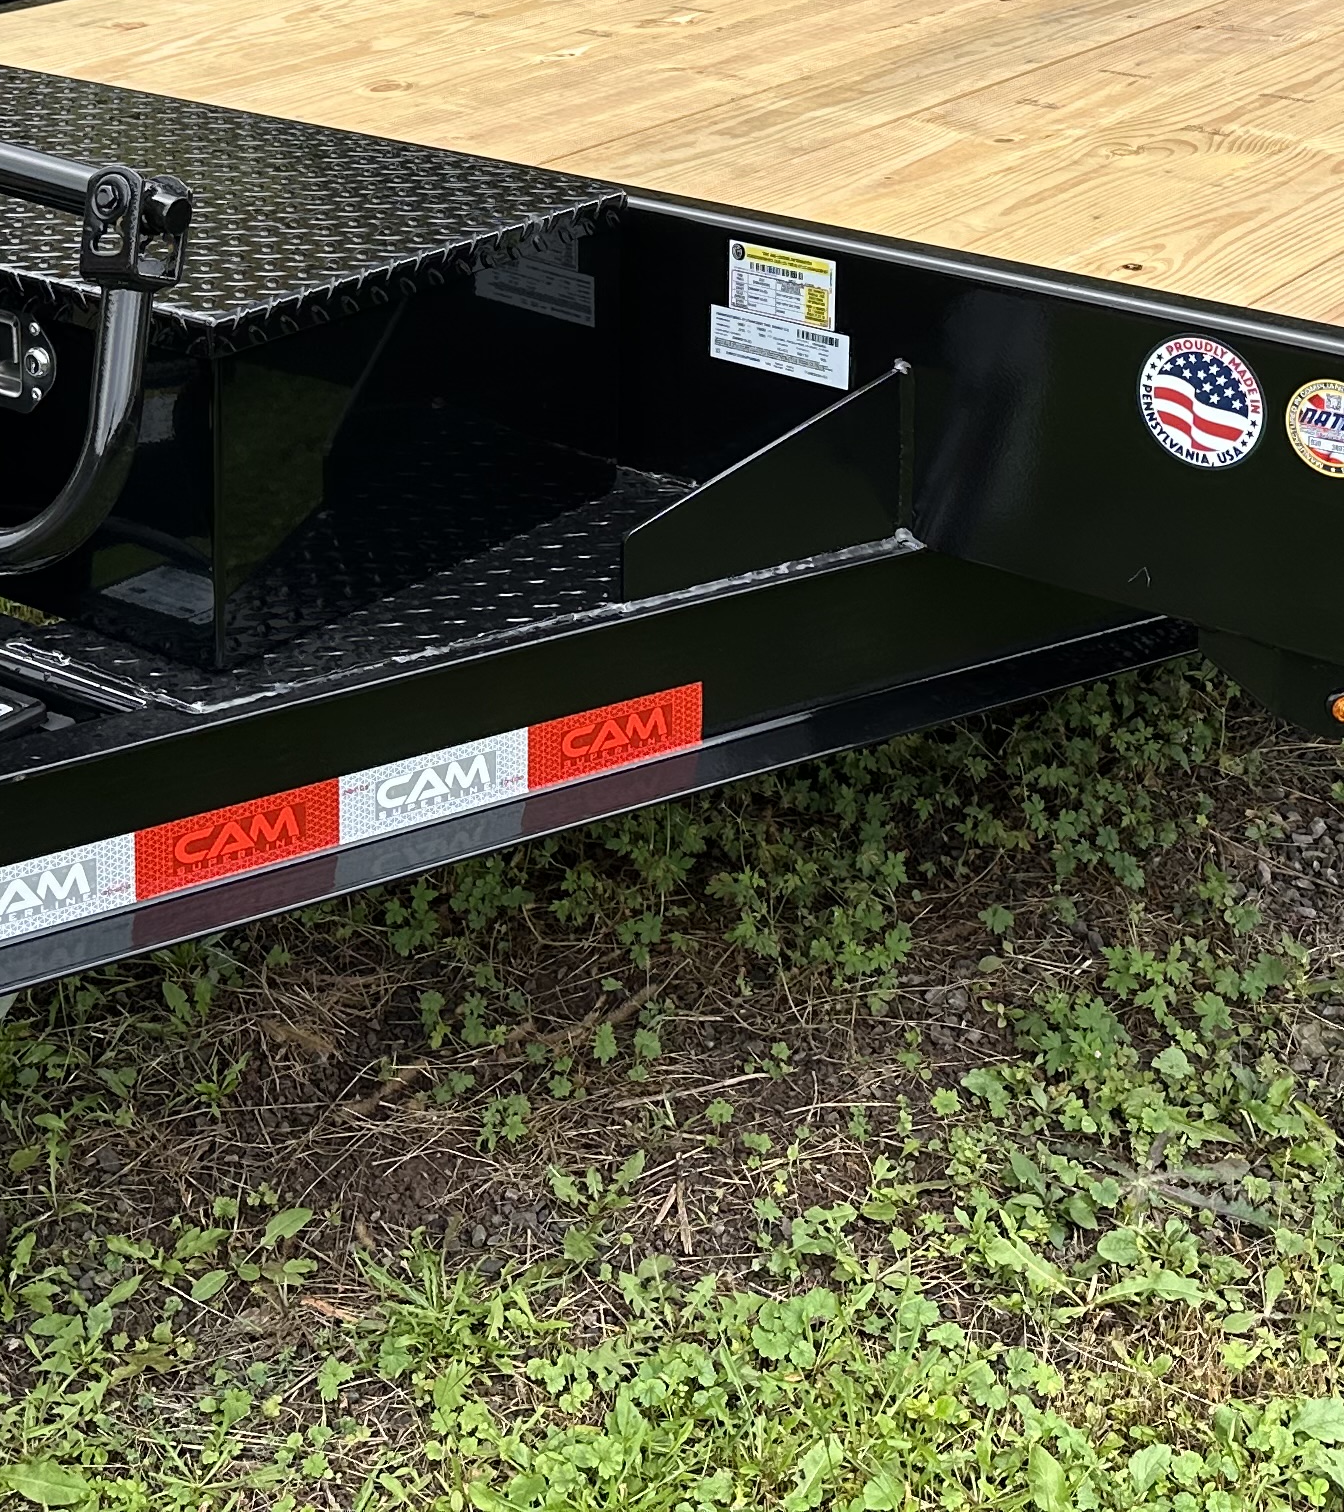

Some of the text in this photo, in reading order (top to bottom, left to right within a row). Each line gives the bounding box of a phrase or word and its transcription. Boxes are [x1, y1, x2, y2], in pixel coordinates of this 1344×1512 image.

[1165, 339, 1261, 414] PROUDLY MADE IN
[1217, 446, 1244, 464] USA
[561, 706, 668, 758] CAM
[376, 754, 491, 809] CAM
[174, 805, 299, 864] CAM
[176, 833, 301, 875] SUPERLINE
